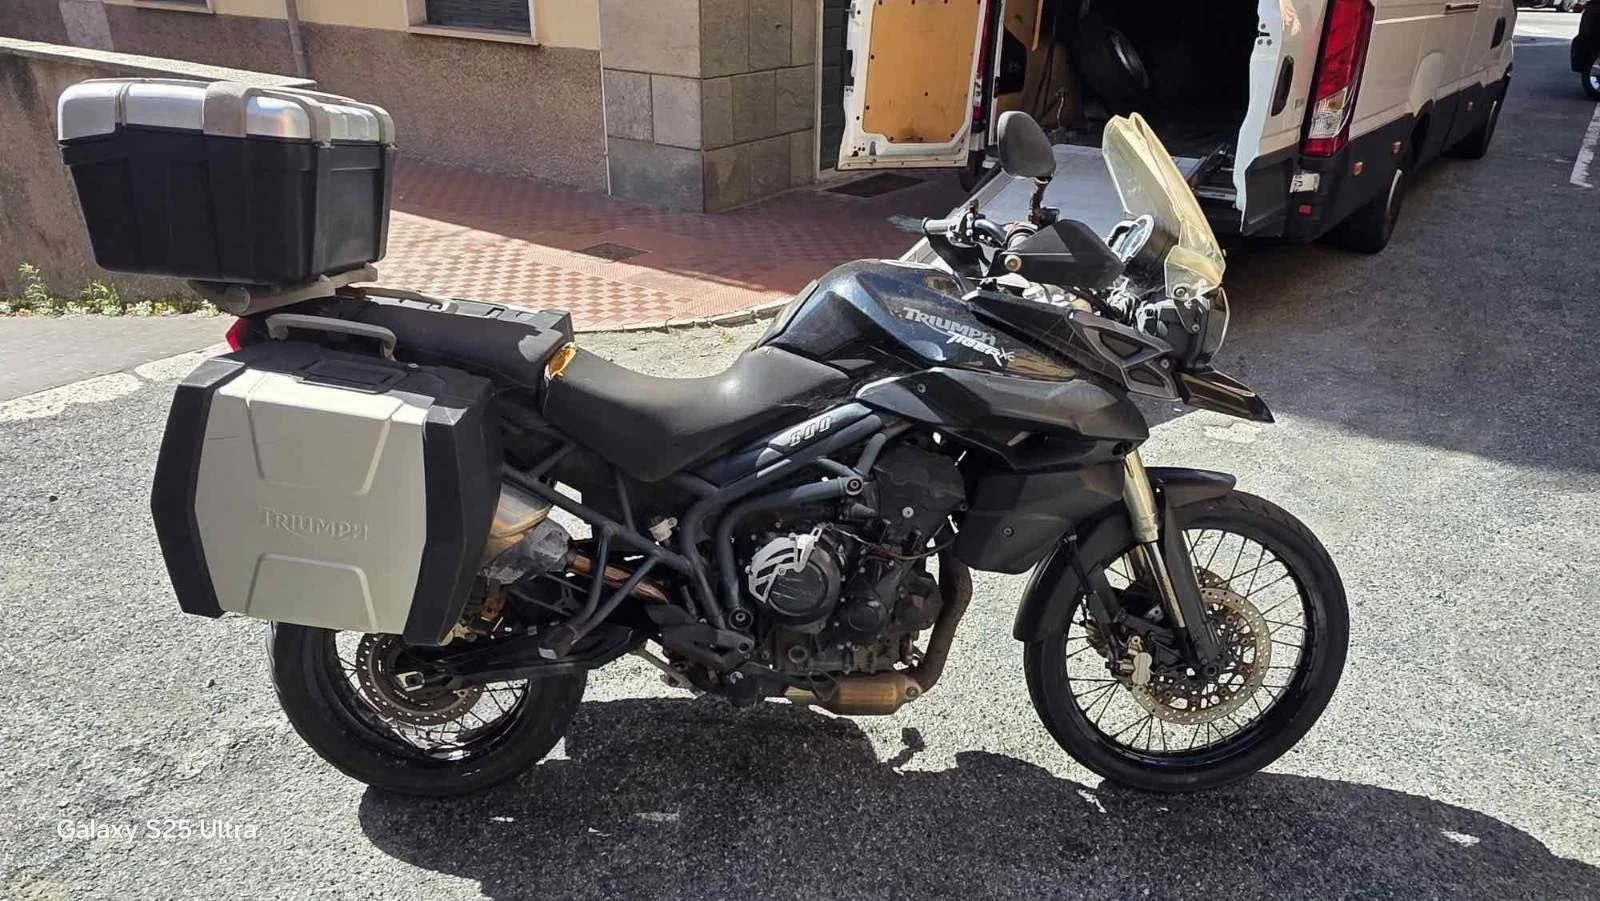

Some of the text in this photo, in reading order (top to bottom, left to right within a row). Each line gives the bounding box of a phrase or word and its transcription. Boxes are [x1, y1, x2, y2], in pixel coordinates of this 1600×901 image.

[903, 306, 997, 346] TRIUMPH
[946, 330, 1003, 367] TIGER
[788, 415, 832, 447] 800
[258, 505, 368, 542] TRIUMPH
